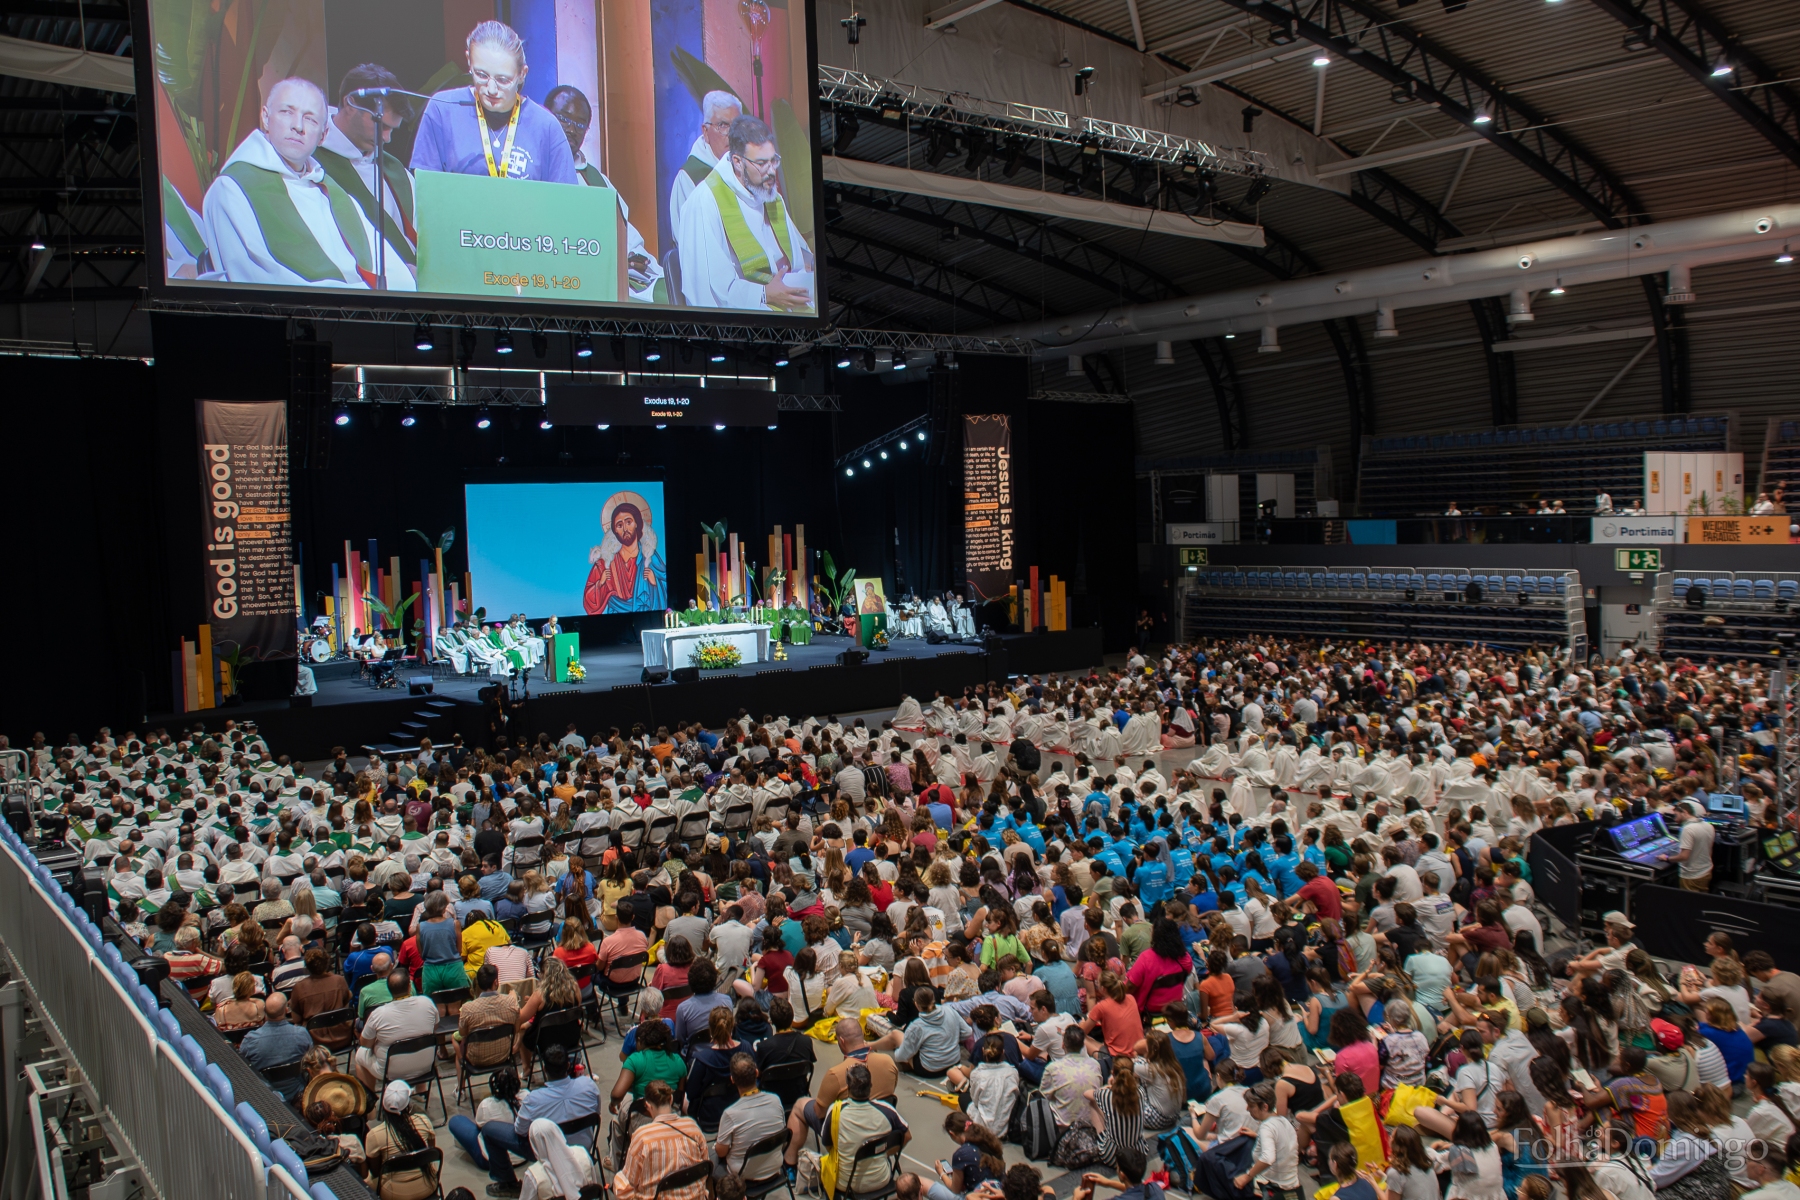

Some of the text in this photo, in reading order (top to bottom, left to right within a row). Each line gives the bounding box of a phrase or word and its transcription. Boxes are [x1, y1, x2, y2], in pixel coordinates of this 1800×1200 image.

[460, 230, 600, 256] Exodus 19, 1-20
[484, 271, 580, 289] Exode 19, 1-20
[998, 446, 1014, 570] Jesus is king
[204, 444, 239, 619] God is good
[1620, 527, 1674, 536] Portimão
[1702, 521, 1740, 531] WELCOME
[1703, 531, 1741, 541] PARADISE
